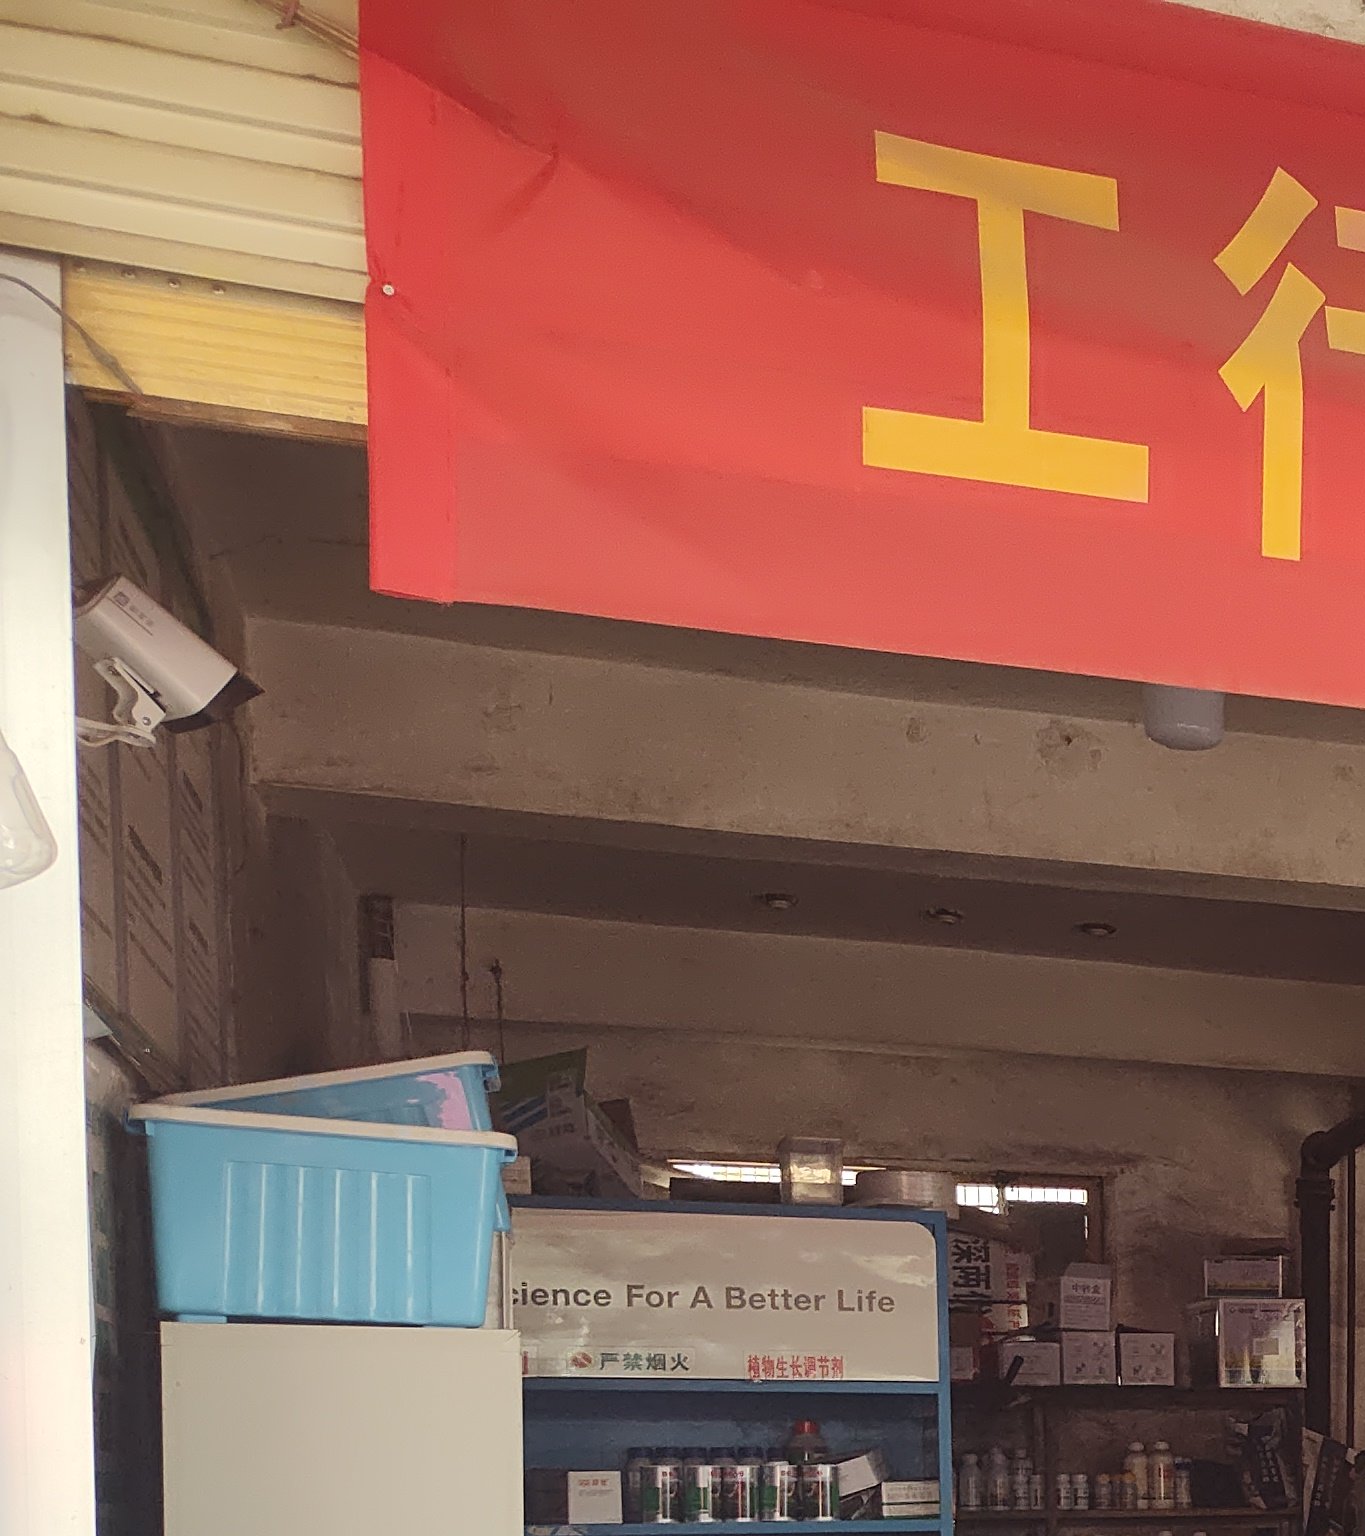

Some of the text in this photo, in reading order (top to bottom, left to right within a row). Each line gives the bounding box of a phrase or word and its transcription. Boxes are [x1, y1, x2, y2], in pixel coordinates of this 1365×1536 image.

[626, 1284, 680, 1309] For
[689, 1285, 714, 1310] A
[725, 1286, 826, 1312] Better
[837, 1289, 896, 1313] Life
[600, 1351, 690, 1373] 严禁烟火
[746, 1353, 845, 1380] 植物生长调节剂
